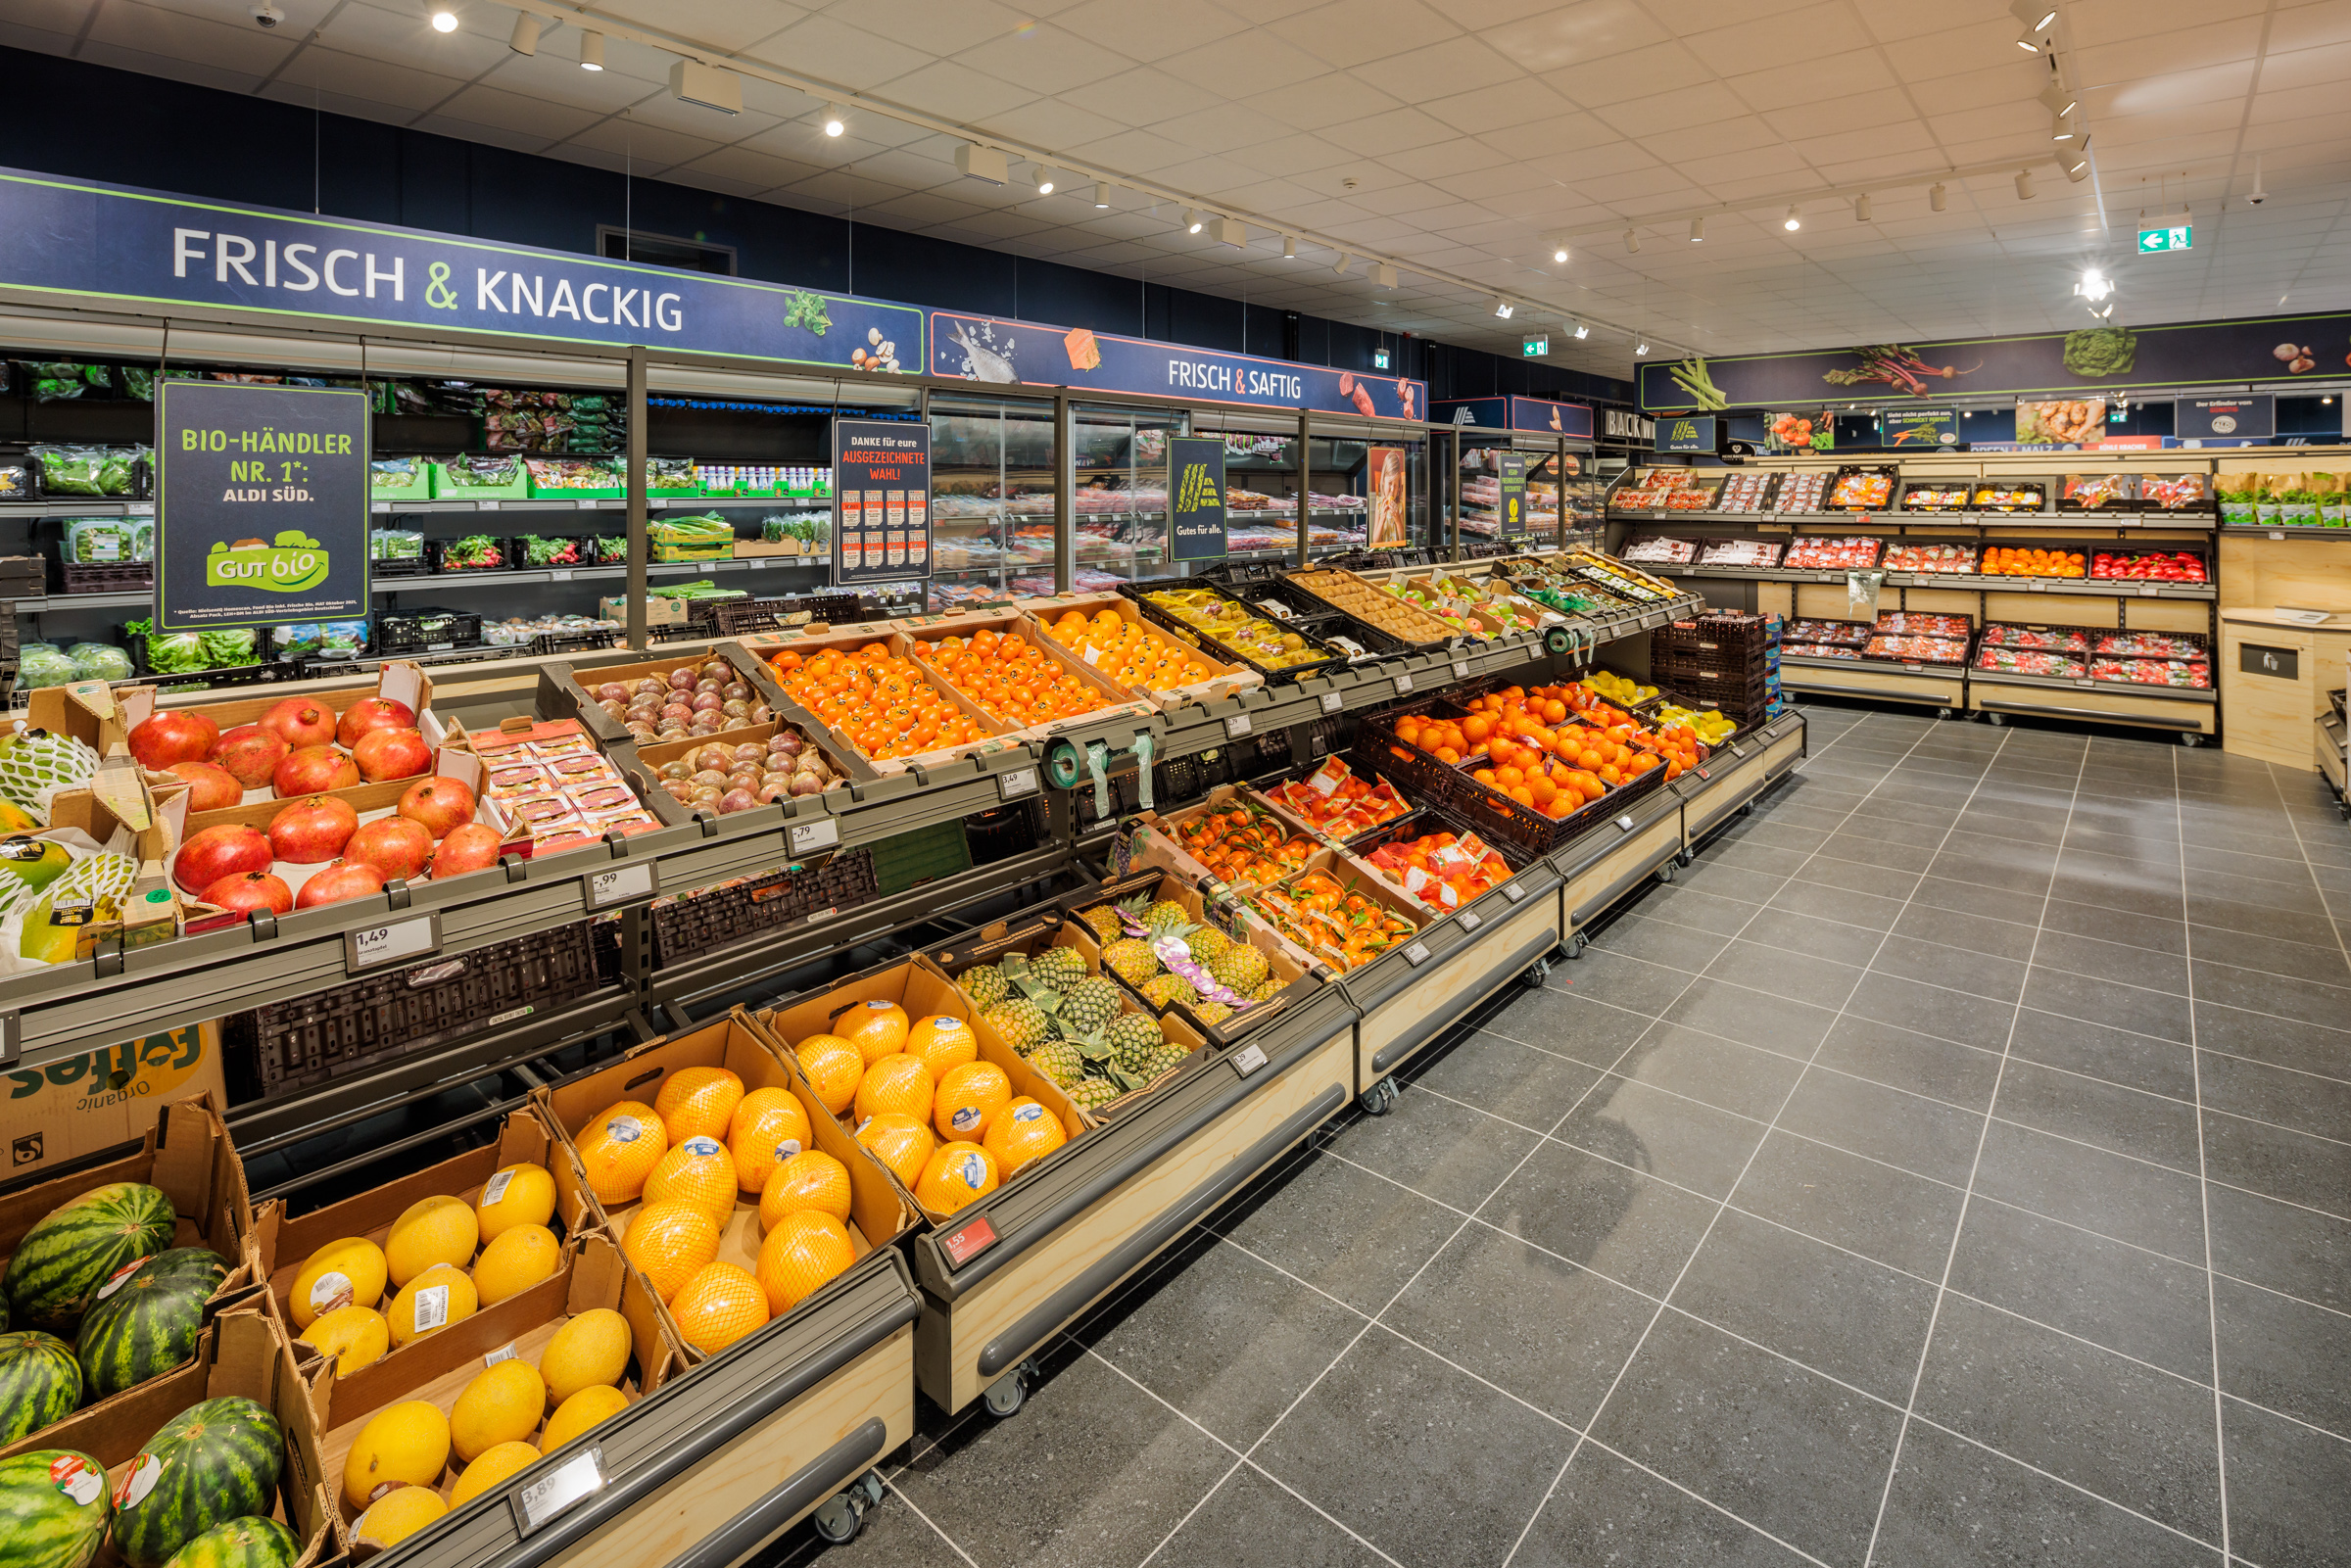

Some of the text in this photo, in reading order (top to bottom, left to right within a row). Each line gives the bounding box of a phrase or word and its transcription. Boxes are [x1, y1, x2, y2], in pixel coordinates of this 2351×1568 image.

[174, 227, 683, 331] FRISCH & KNACKIG
[1169, 359, 1301, 399] FRISCH & SAFTIG
[1606, 410, 1655, 440] BACKW
[182, 427, 352, 454] BIO-HÄNDLER
[851, 437, 881, 447] DANKE
[883, 437, 896, 447] für
[842, 451, 926, 465] AUSGEZEICHNETE
[230, 460, 272, 483] NR.
[869, 468, 900, 480] WAHL!
[223, 485, 314, 502] ALDI SÜD.
[1176, 524, 1222, 536] Gutes für alle.
[216, 551, 315, 578] GUT bio
[564, 760, 592, 770] Physalis
[500, 771, 530, 783] Physalis
[1003, 774, 1017, 784] 3,49
[793, 826, 810, 838] -,79
[594, 873, 617, 888] -,99
[357, 928, 388, 946] 1,49
[358, 944, 387, 955] Granatapfel
[76, 1080, 150, 1113] Organic
[14, 1132, 43, 1145] FAIRTRADE
[946, 1232, 966, 1249] 1,55
[523, 1477, 556, 1505] 3,89
